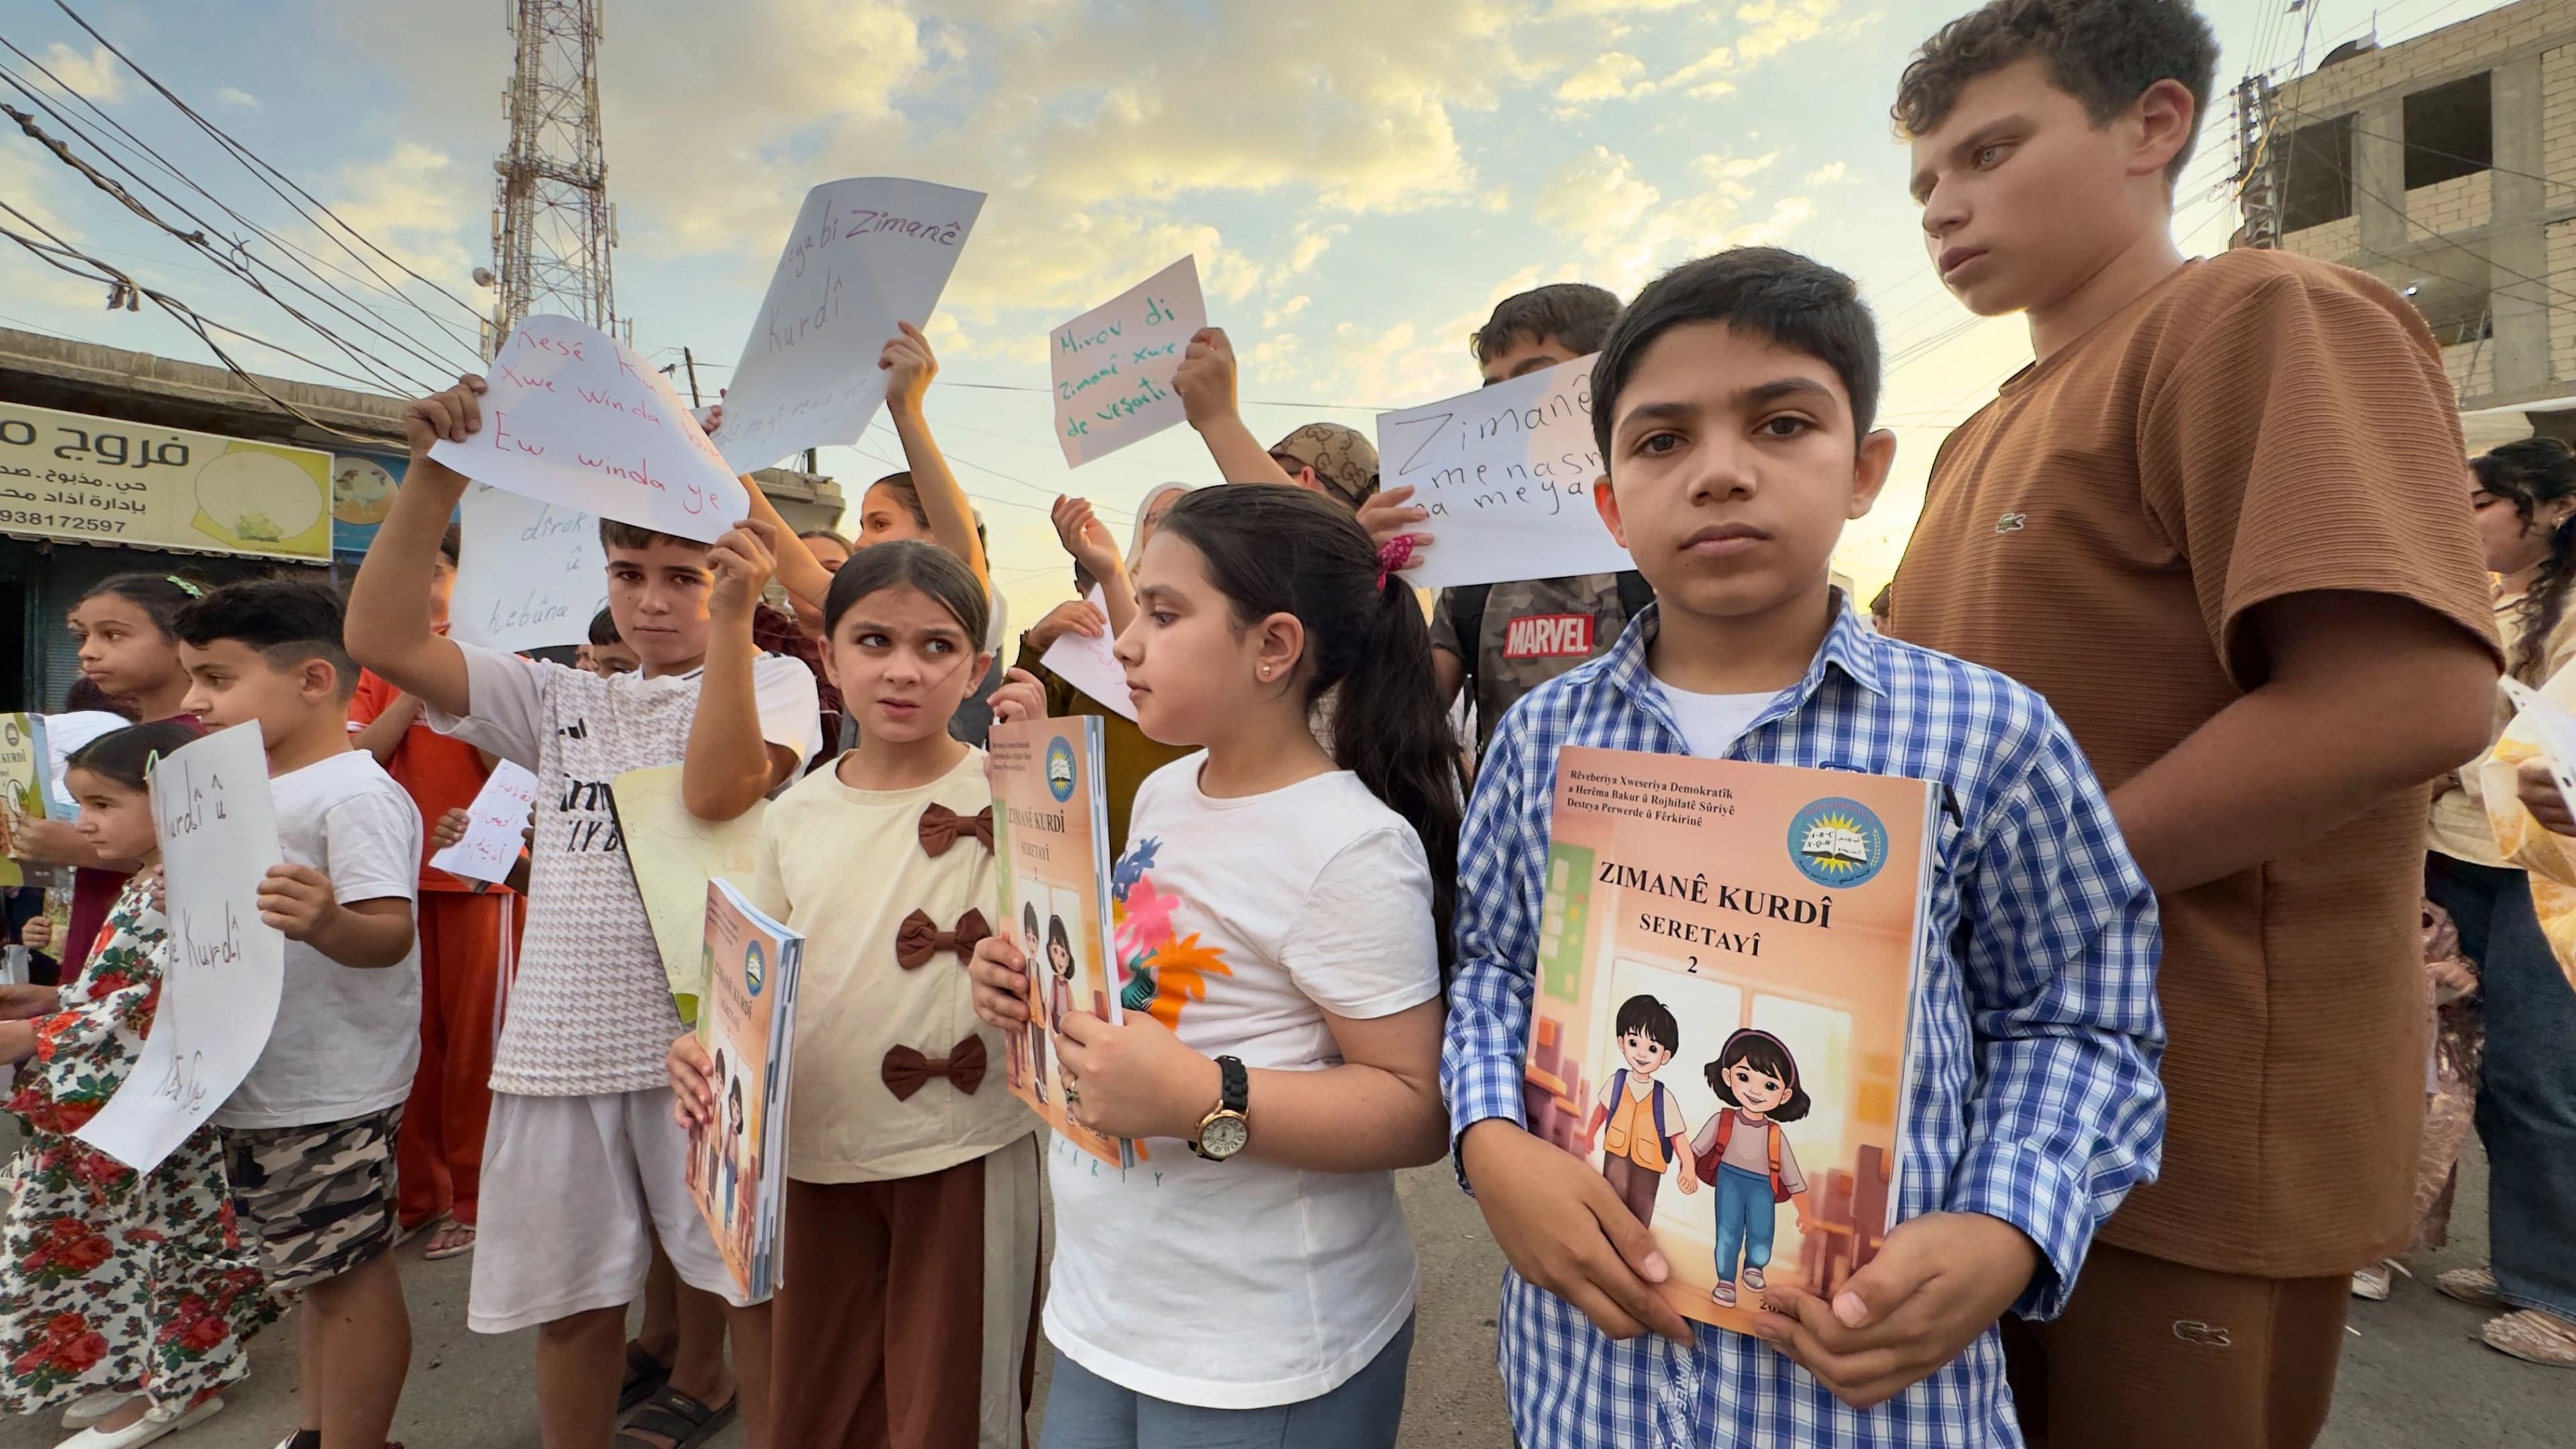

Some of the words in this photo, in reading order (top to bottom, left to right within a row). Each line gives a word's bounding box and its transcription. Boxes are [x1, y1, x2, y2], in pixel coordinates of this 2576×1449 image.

[1146, 297, 1175, 326] di
[1067, 416, 1088, 437] de
[1395, 373, 1592, 476] Zimanê
[54, 427, 190, 468] فروج
[1506, 618, 1589, 656] MARVEL
[1570, 769, 1617, 786] Rêveberiya
[1620, 775, 1667, 792] Xweseriya
[1670, 781, 1733, 800] Demokratîk
[1576, 784, 1609, 798] Herêma
[1611, 790, 1640, 803] Bakur
[1642, 794, 1648, 804] û
[1651, 794, 1697, 810] Rojhilatê
[1699, 801, 1735, 817] Sûriyê
[1034, 809, 1065, 834] KURDÎ
[1567, 797, 1599, 812] Desteya
[1601, 802, 1644, 818] Perwerde
[1646, 809, 1652, 819] û
[1655, 810, 1703, 827] Fêrkirinê
[1598, 860, 1709, 905] ZIMANÊ
[1717, 885, 1834, 929] KURDÎ
[182, 901, 241, 970] Kurdî
[1639, 912, 1762, 957] SERETAYÎ
[1686, 956, 1698, 973] 2
